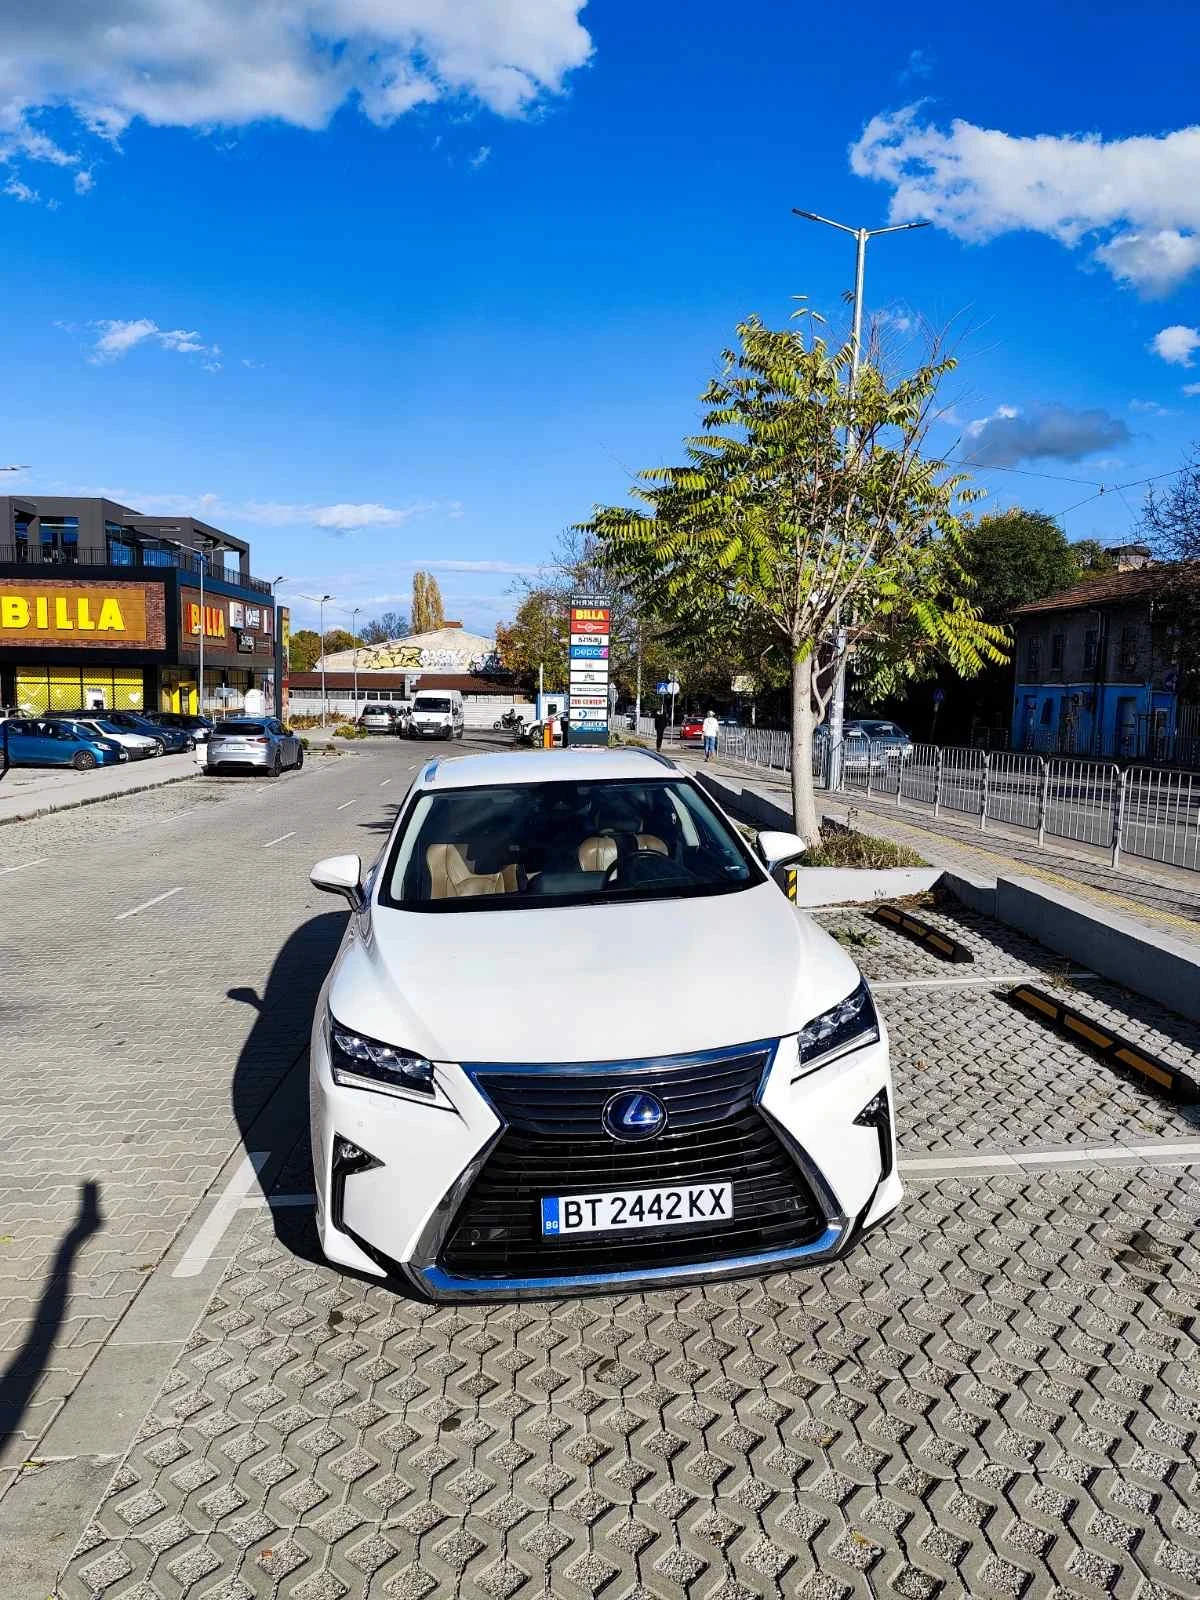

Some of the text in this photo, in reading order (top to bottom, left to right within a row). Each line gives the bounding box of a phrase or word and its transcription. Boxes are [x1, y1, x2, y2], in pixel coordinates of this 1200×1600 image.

[1, 597, 125, 631] BILLA
[187, 602, 225, 638] BILLA
[576, 609, 604, 620] BILLA
[575, 648, 604, 656] pepco
[546, 1187, 726, 1230] BG BT 2442 KX
